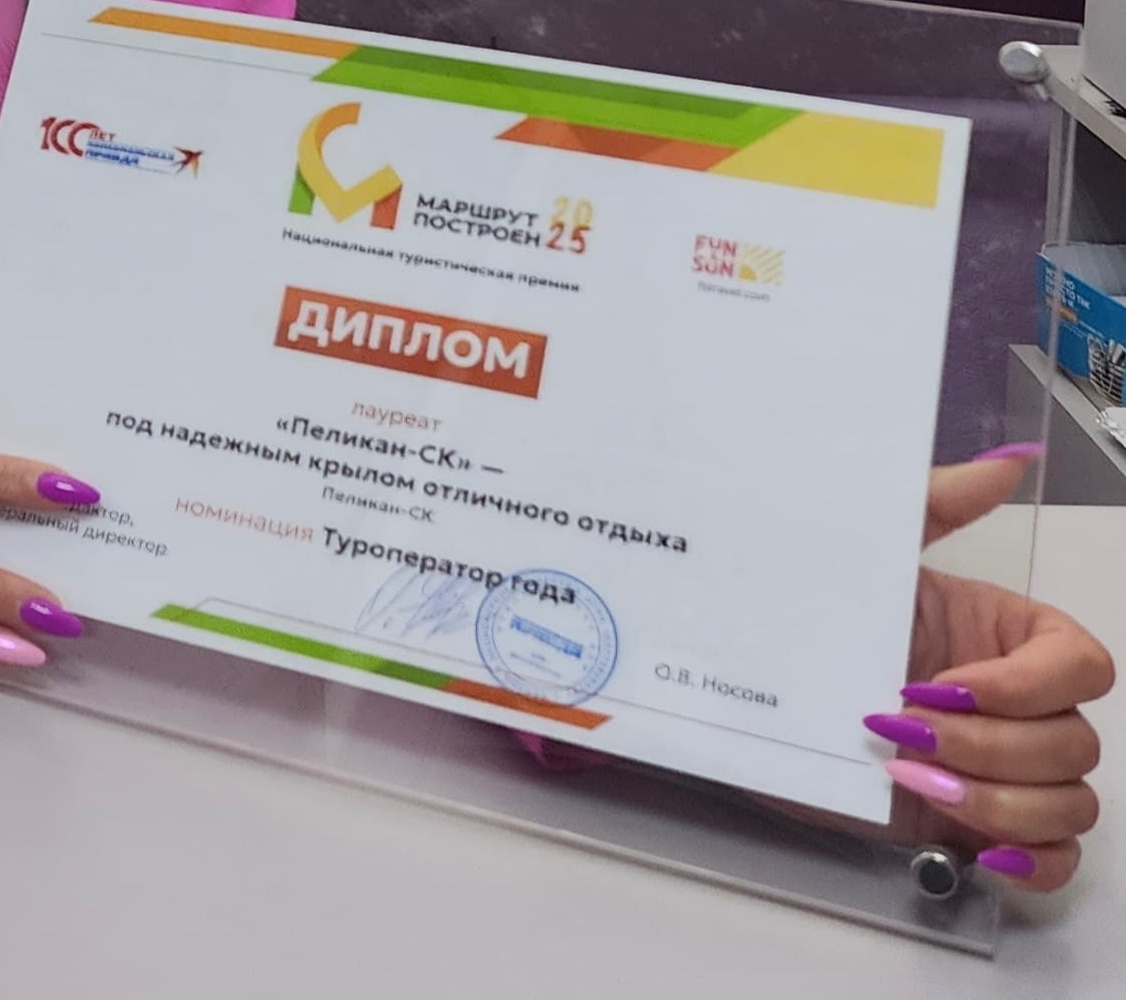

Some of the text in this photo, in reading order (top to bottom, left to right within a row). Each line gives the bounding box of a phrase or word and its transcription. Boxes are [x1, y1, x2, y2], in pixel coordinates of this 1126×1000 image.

[90, 128, 116, 142] ЛЕТ
[417, 194, 539, 227] МАРШРУТ
[551, 196, 594, 228] 20
[413, 212, 541, 248] ПОСТРОЕН
[547, 221, 592, 254] 25
[282, 228, 582, 293] Национальная туристическая премия
[287, 299, 532, 379] ДИПЛОМ
[351, 401, 443, 430] лауреат
[276, 415, 472, 472] «Пеликан-СК»
[105, 409, 689, 554] под надежным крылом отличного отдыха
[66, 502, 135, 527] дактор,
[322, 485, 434, 523] Пеликан-СК
[81, 525, 169, 557] директор
[174, 497, 577, 605] номинация Туроператор года
[654, 662, 778, 708] О.В. Носова
